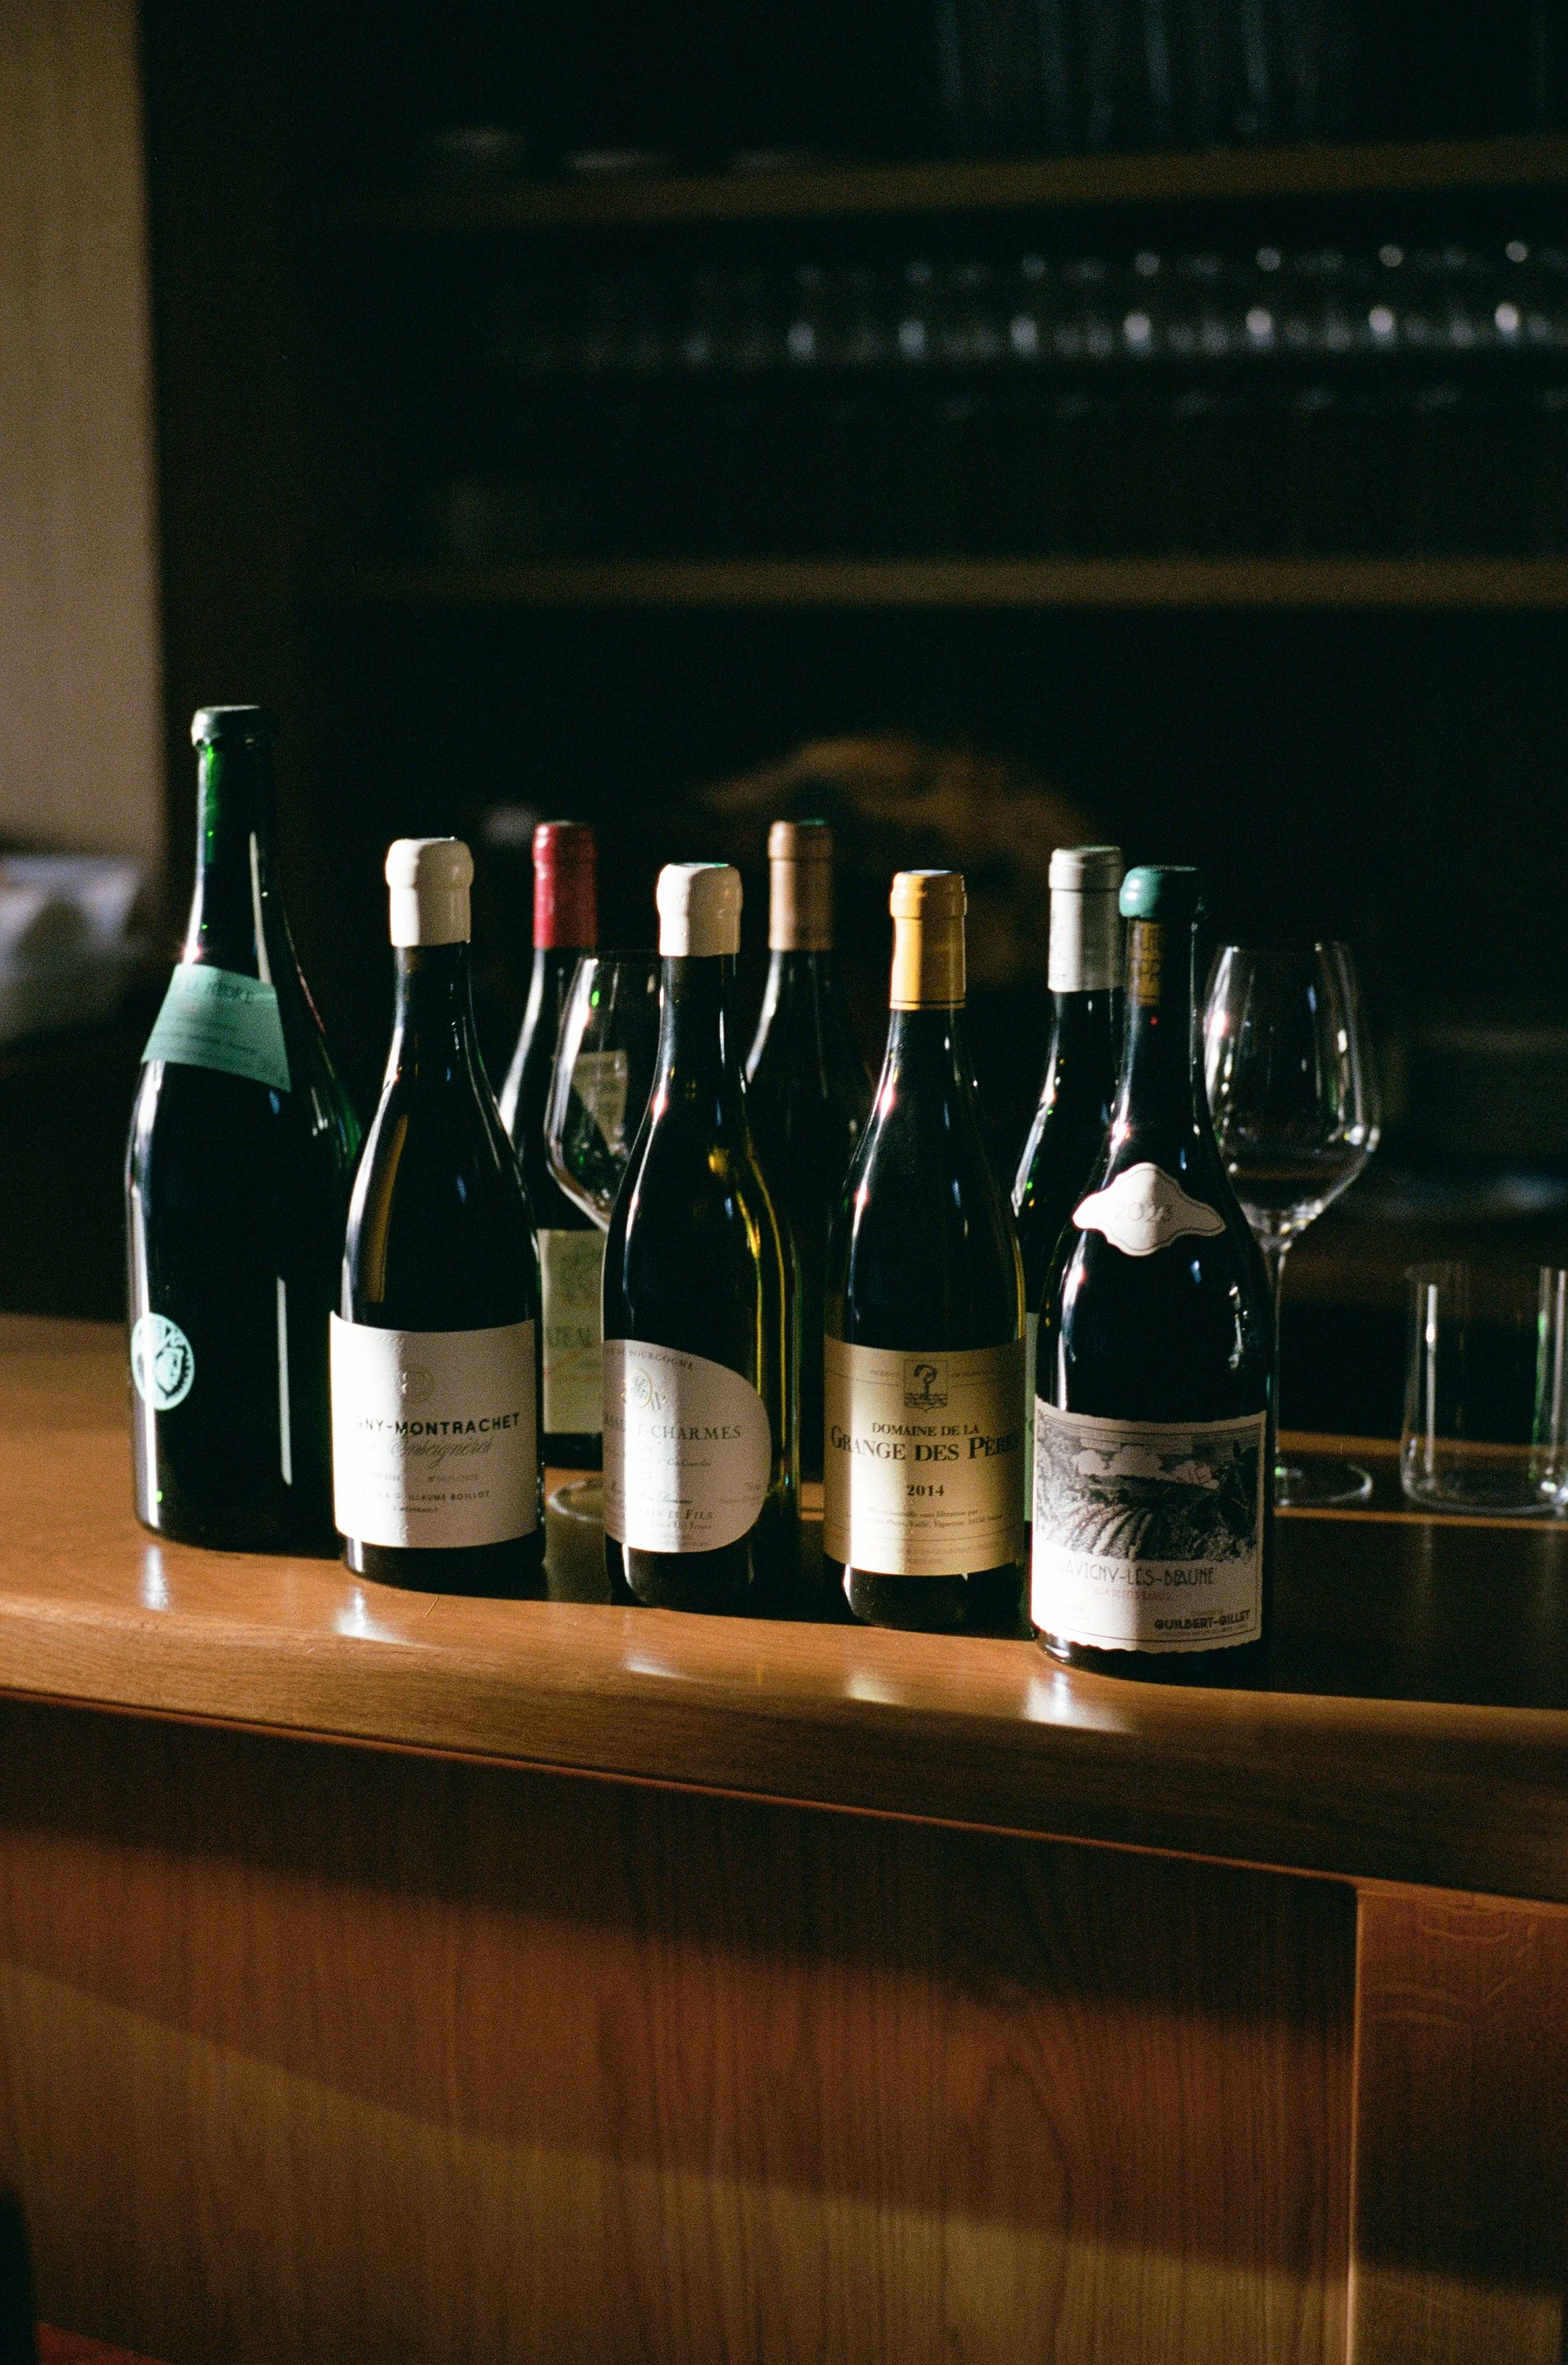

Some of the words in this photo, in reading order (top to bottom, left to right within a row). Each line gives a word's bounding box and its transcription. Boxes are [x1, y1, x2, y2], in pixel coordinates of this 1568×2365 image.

[872, 1422, 936, 1437] DOMAINE
[941, 1425, 959, 1436] DE
[964, 1424, 979, 1435] LA
[830, 1425, 906, 1461] GRANGE
[915, 1444, 960, 1462] DES
[906, 1484, 945, 1497] 2014
